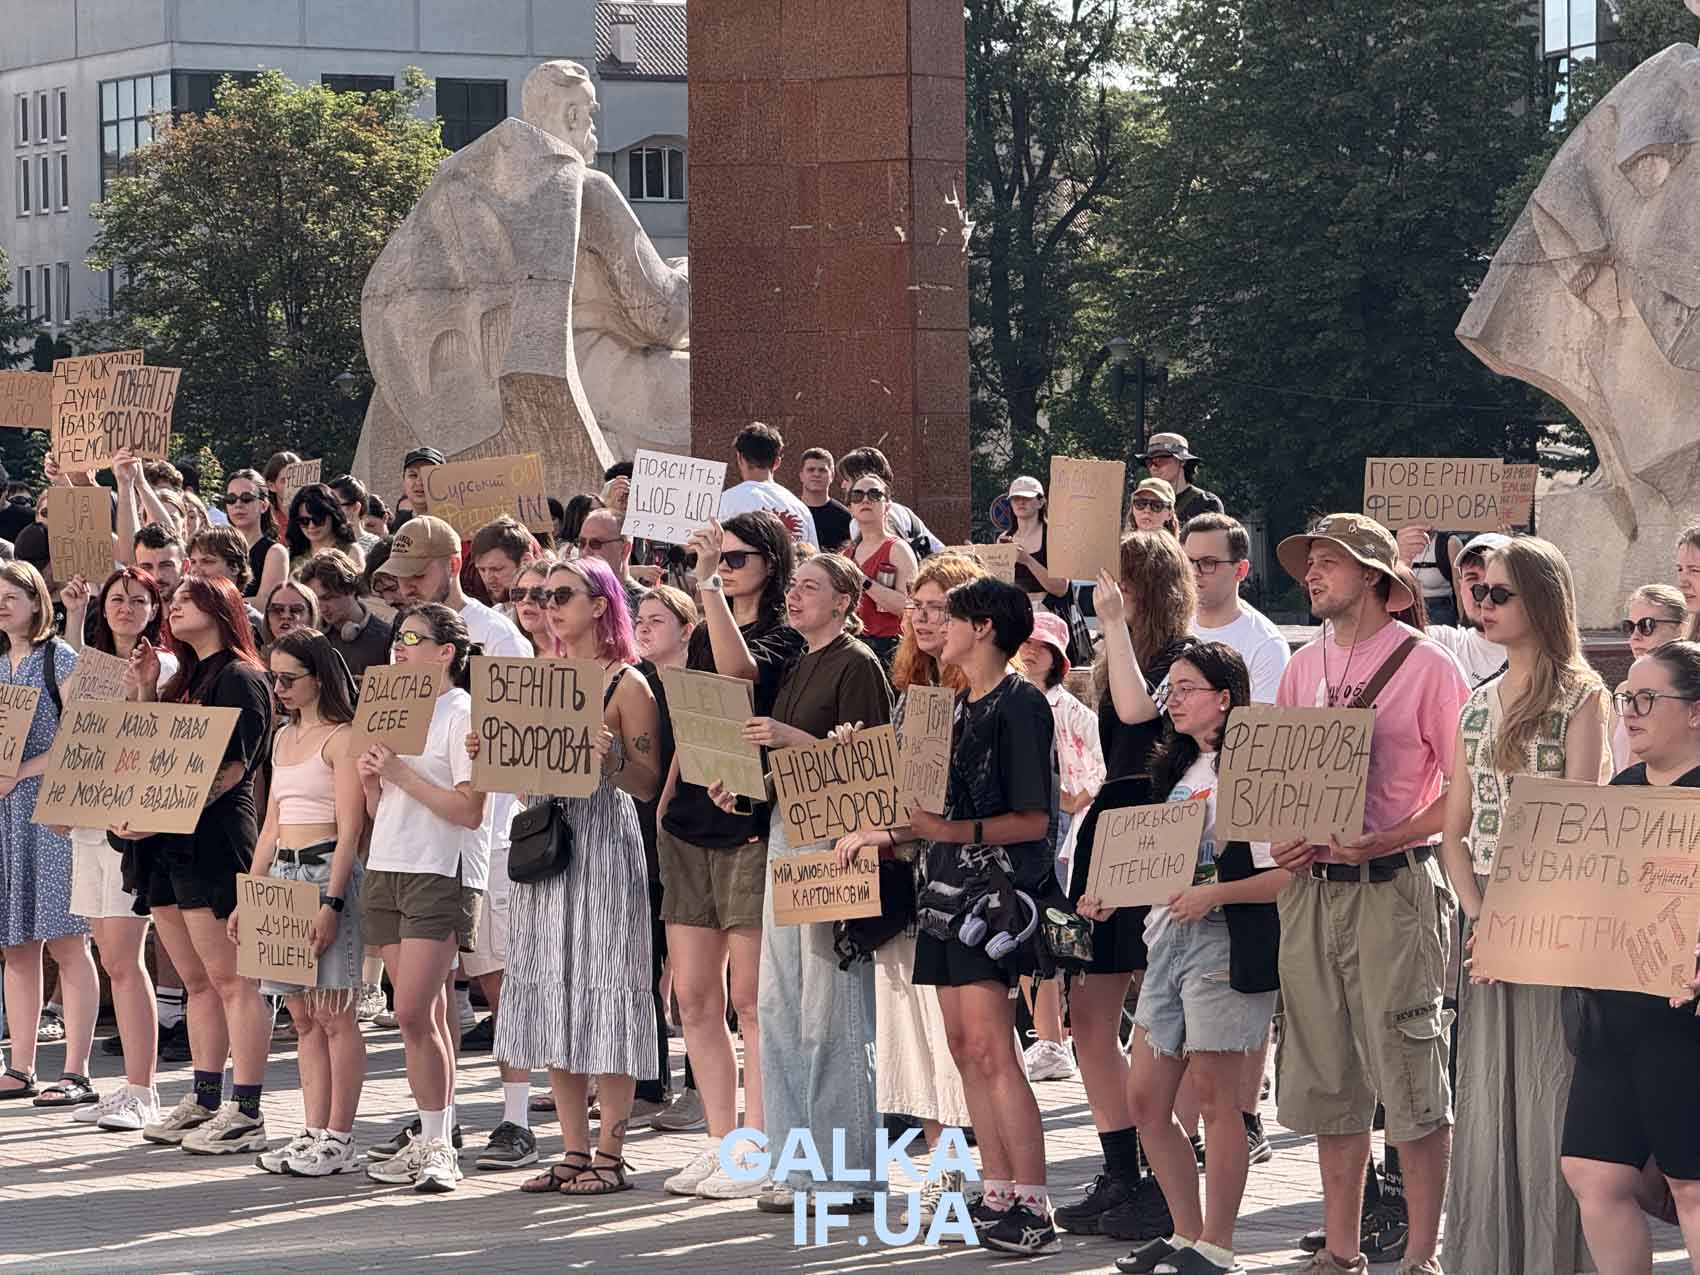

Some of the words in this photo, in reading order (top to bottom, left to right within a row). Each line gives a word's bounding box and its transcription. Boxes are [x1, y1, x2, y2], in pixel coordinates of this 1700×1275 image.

[111, 368, 176, 413] ПОВЕРНІТЬ
[1370, 462, 1500, 489] ПОВЕРНІТЬ
[364, 672, 433, 703] ВІДСТАВ
[486, 662, 587, 711] ВЕРНІТЬ
[367, 709, 408, 733] СЕБЕ
[1223, 720, 1370, 777] ФЕДОРОВА
[1111, 802, 1199, 838] СИРСЬКОГО
[1231, 774, 1363, 833] ВИРНІТ!
[1138, 833, 1155, 852] НА
[1495, 846, 1630, 886] БУВАЮТЬ
[244, 879, 295, 913] ПРОТИ
[792, 880, 870, 907] КАРТОНКОВИЙ
[255, 913, 313, 939] ДУРНИ
[1488, 911, 1628, 951] МІНІСТРИ
[257, 941, 313, 969] РІШЕНЬ
